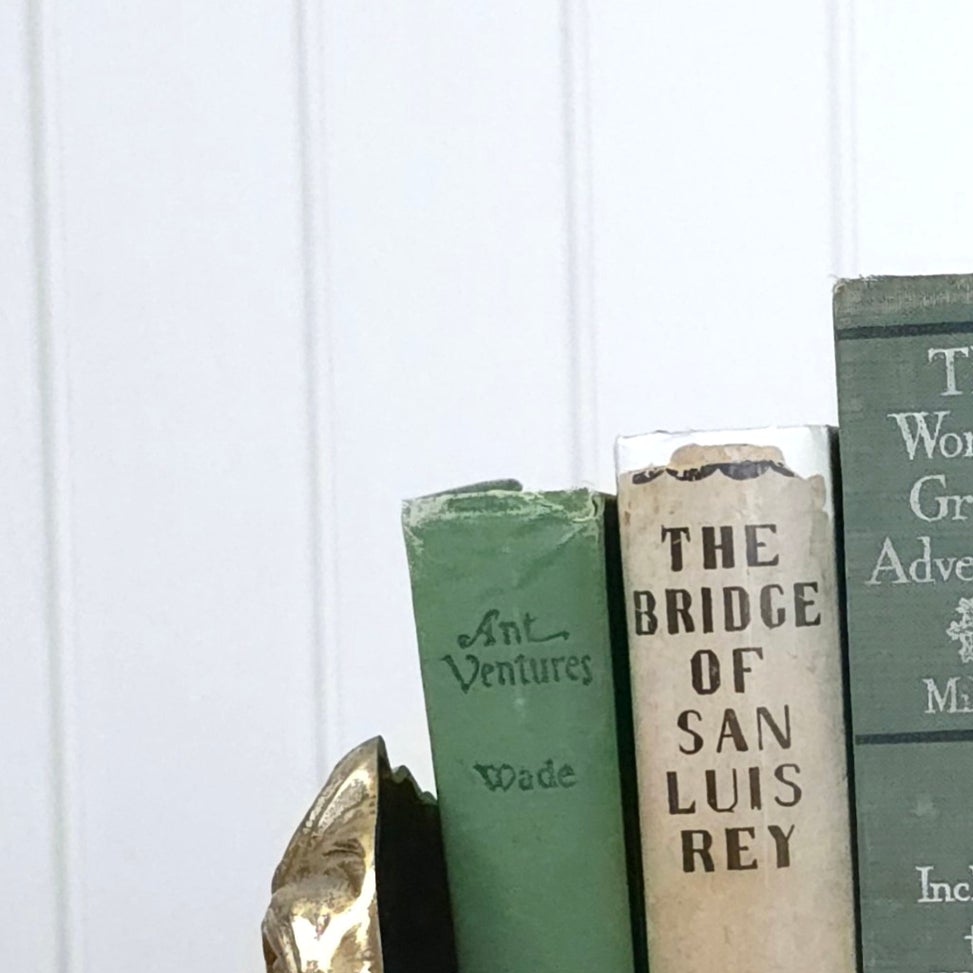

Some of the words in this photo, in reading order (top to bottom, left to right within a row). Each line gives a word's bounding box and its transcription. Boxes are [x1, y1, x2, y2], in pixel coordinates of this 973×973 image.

[661, 523, 780, 572] THE
[457, 608, 570, 648] Ant
[633, 581, 821, 636] BRIDGE
[441, 654, 593, 693] Ventures
[690, 646, 764, 696] OF
[676, 704, 792, 755] SAN
[473, 758, 577, 791] Wade
[666, 763, 802, 815] LUIS
[681, 824, 795, 873] REY
